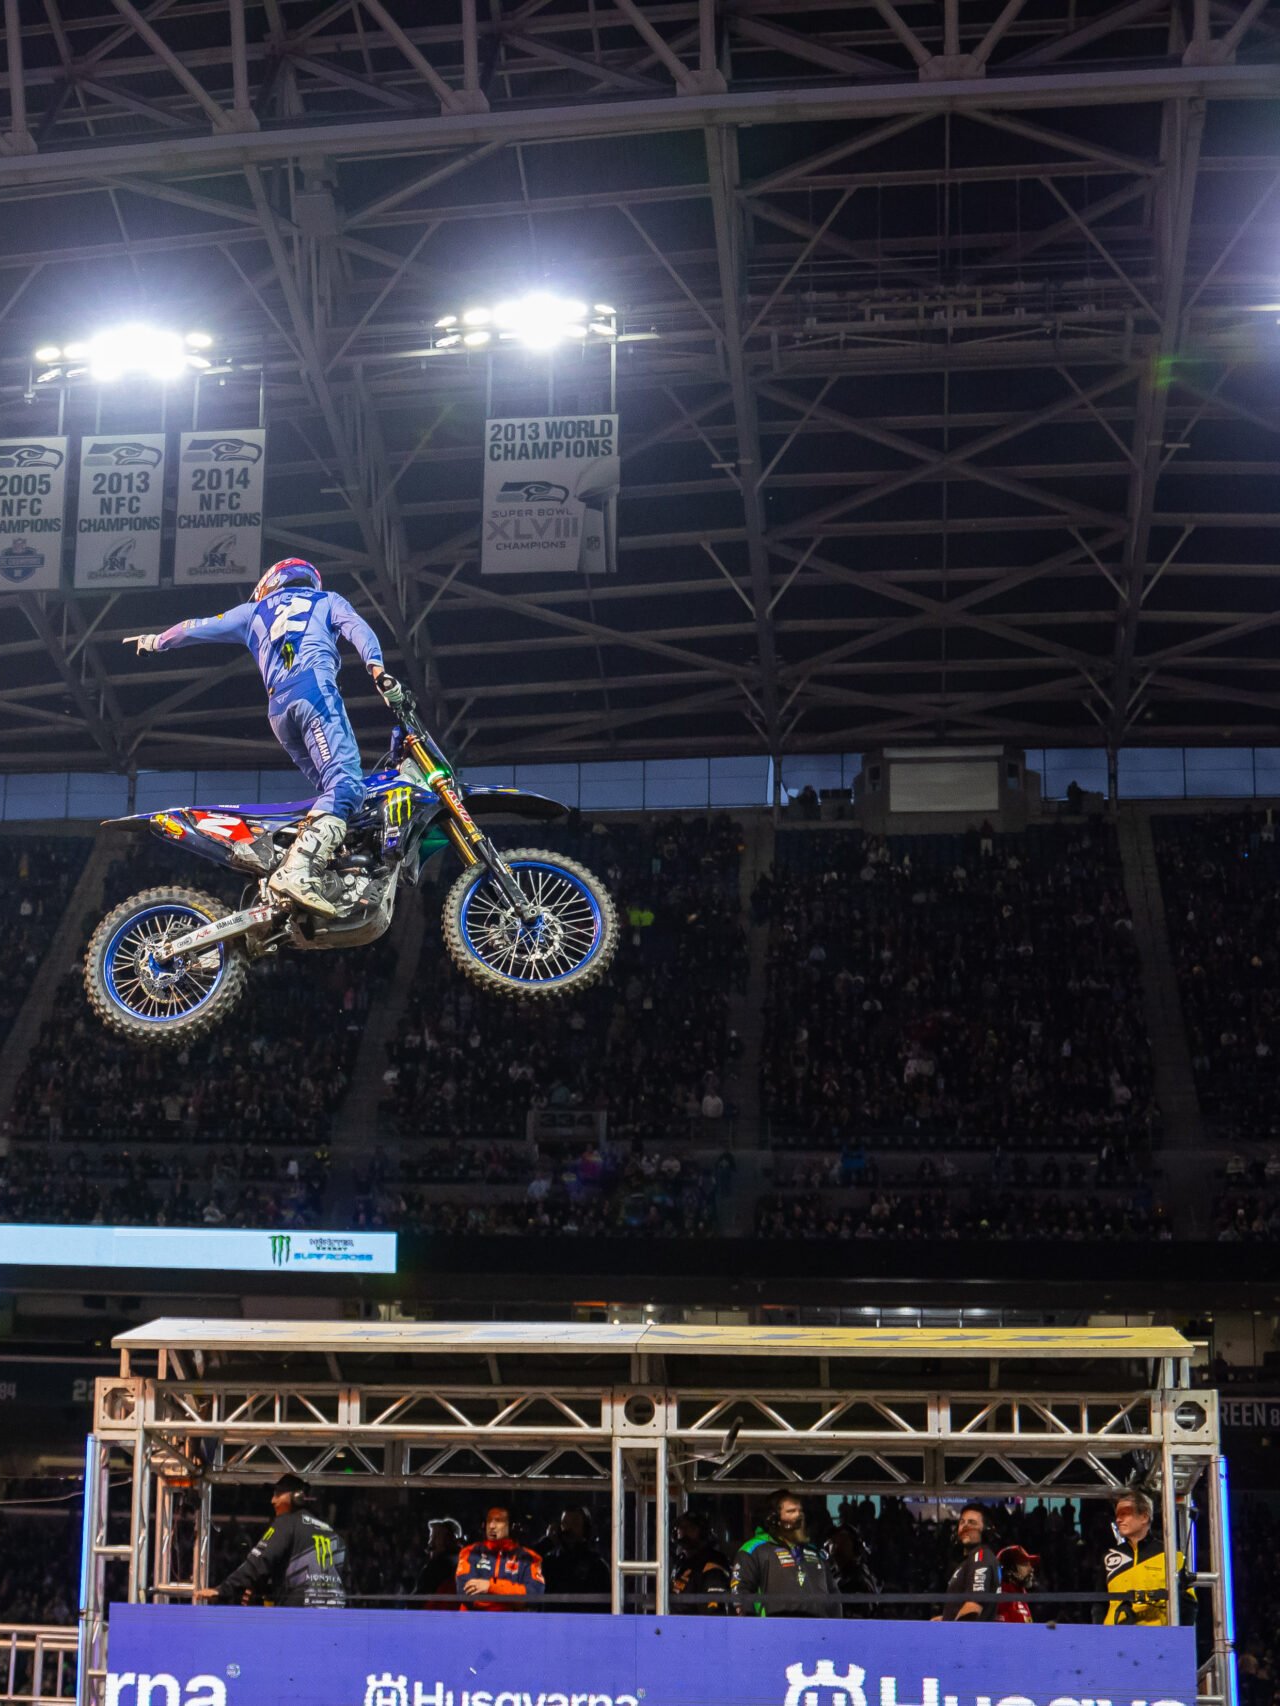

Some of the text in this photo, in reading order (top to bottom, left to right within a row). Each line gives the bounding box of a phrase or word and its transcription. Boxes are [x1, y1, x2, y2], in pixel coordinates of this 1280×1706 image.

[489, 420, 613, 442] 2013 WORLD
[489, 439, 613, 462] CHAMPIONS
[92, 472, 150, 495] 2013
[191, 468, 250, 491] 2014
[1, 499, 42, 517] NFC
[99, 497, 140, 515] NFC
[199, 492, 240, 511] NFC
[178, 513, 261, 529] CHAMPIONS
[491, 508, 573, 519] SUPER BOWL
[78, 517, 160, 532] CHAMPIONS
[487, 517, 579, 541] XLVIII
[496, 541, 566, 550] CHAMPIONS
[270, 597, 312, 641] 2
[313, 727, 331, 762] YAMAHA
